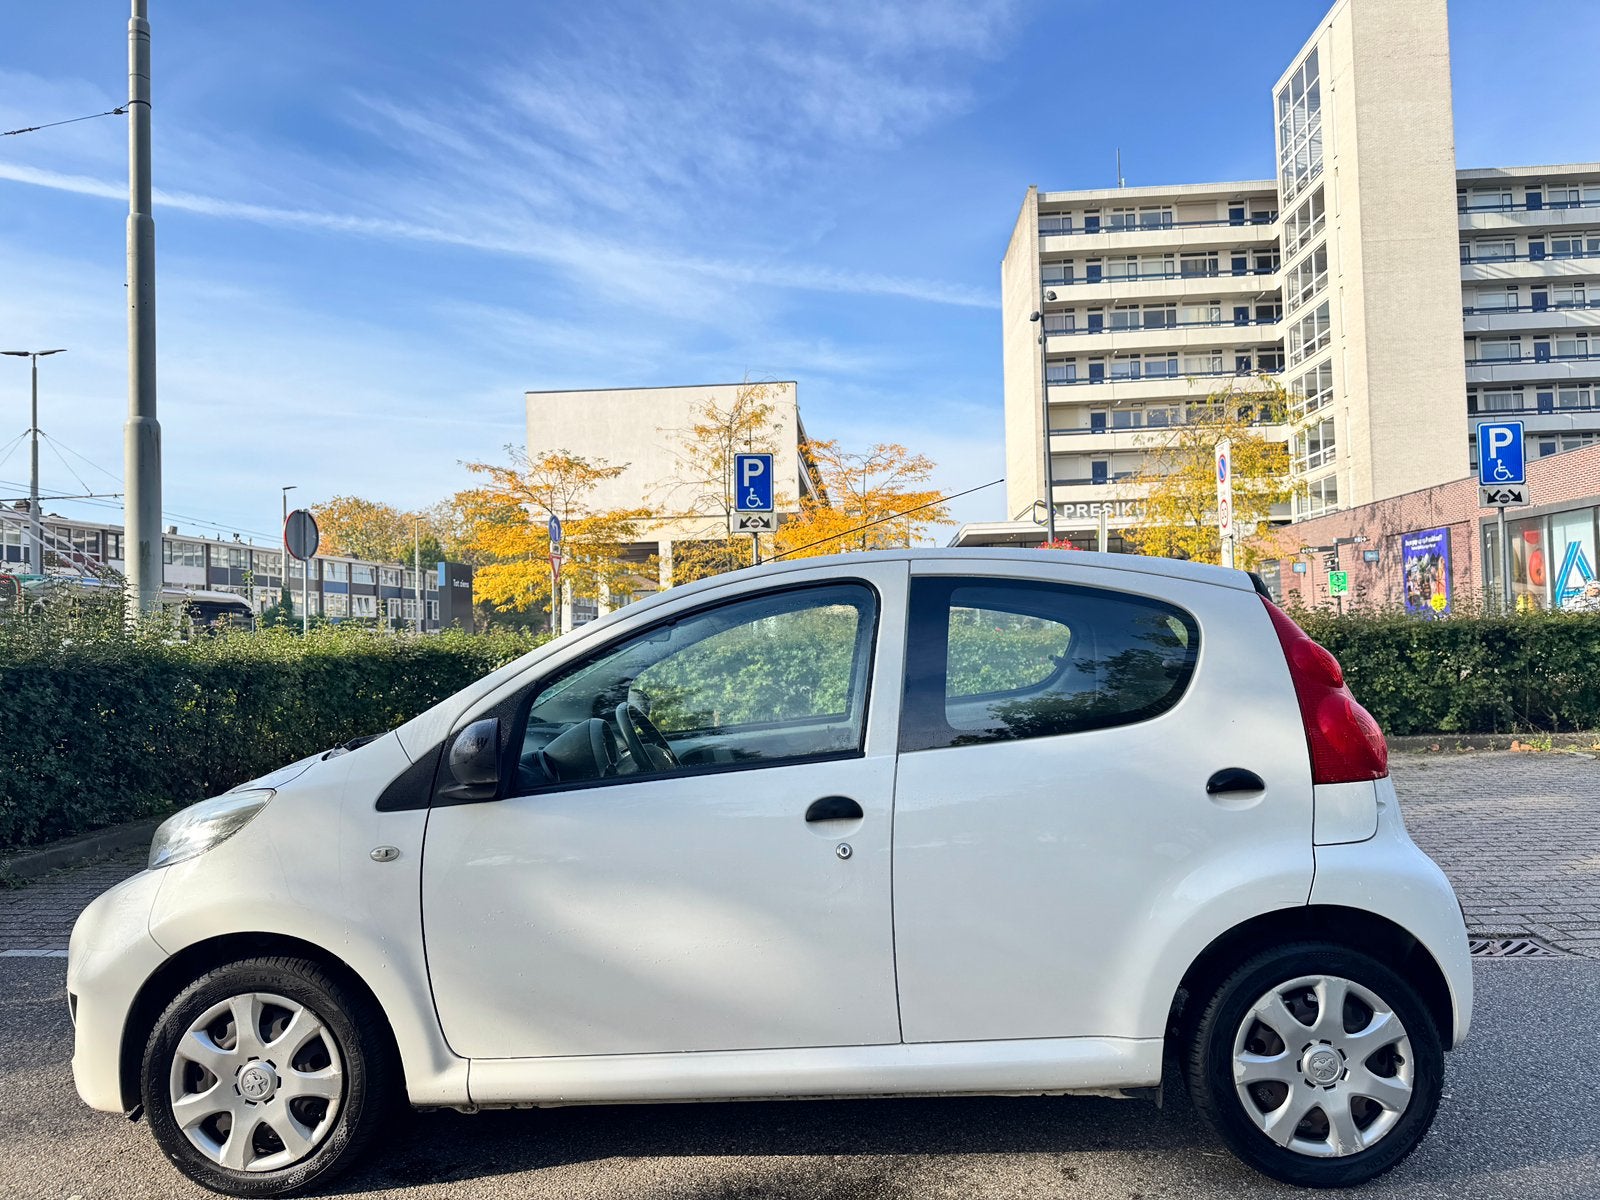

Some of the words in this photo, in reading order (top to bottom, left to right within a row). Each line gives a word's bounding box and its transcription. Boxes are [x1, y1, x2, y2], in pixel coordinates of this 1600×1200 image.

[1489, 428, 1513, 458] P
[743, 459, 764, 487] P
[1063, 501, 1160, 518] PRESIKH
